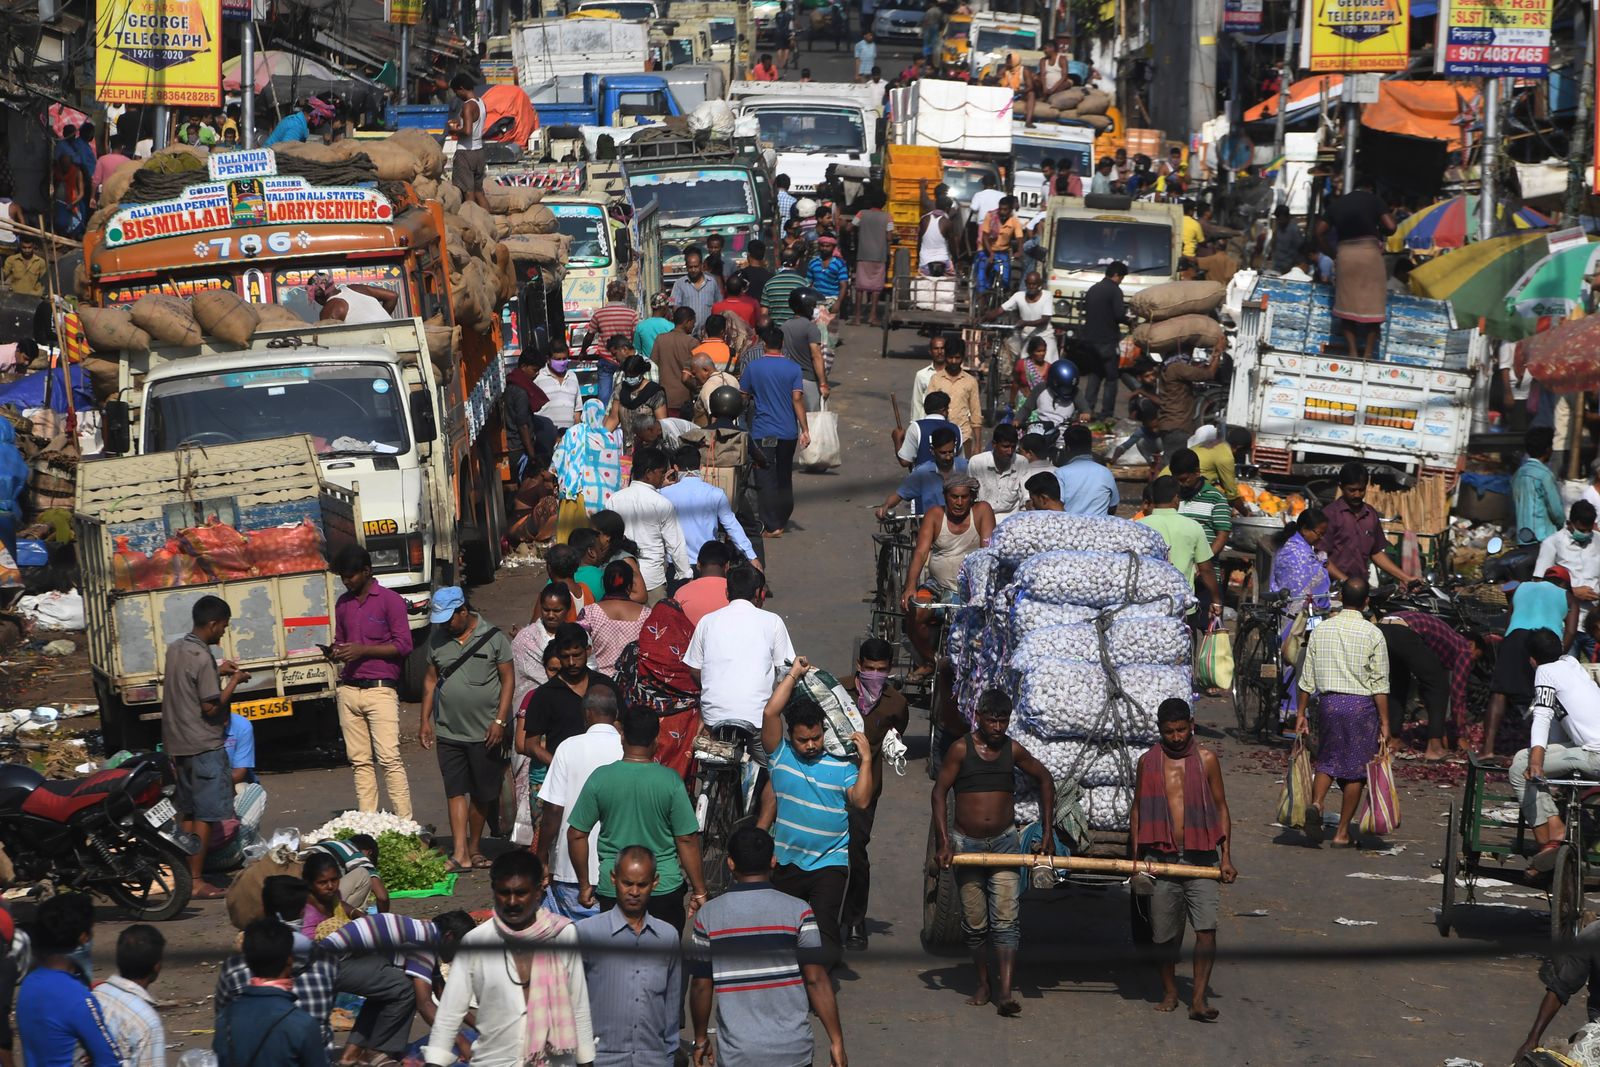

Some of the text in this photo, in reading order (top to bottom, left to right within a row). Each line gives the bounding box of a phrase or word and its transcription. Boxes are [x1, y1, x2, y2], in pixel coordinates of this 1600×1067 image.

[128, 15, 189, 29] GEORGE
[1327, 11, 1395, 22] TELEGRAPH
[1456, 11, 1482, 23] SLST
[1523, 13, 1547, 25] PSC
[115, 31, 202, 47] TELEGRAPH
[133, 49, 154, 59] 1920
[162, 50, 184, 60] 2020
[1459, 46, 1543, 62] 9674087465
[100, 89, 147, 100] HELPLINE
[156, 91, 216, 102] 9836428285
[218, 162, 268, 175] PERMIT
[189, 185, 225, 196] GOODS
[265, 180, 302, 188] CARRIER
[266, 192, 294, 201] VALID
[328, 191, 366, 200] STATES
[185, 198, 228, 210] PERMIT
[268, 201, 378, 221] LORRY SERVICE
[122, 207, 231, 240] BISMILLAH
[282, 668, 327, 684] Traffic Rules
[259, 701, 289, 716] 5456
